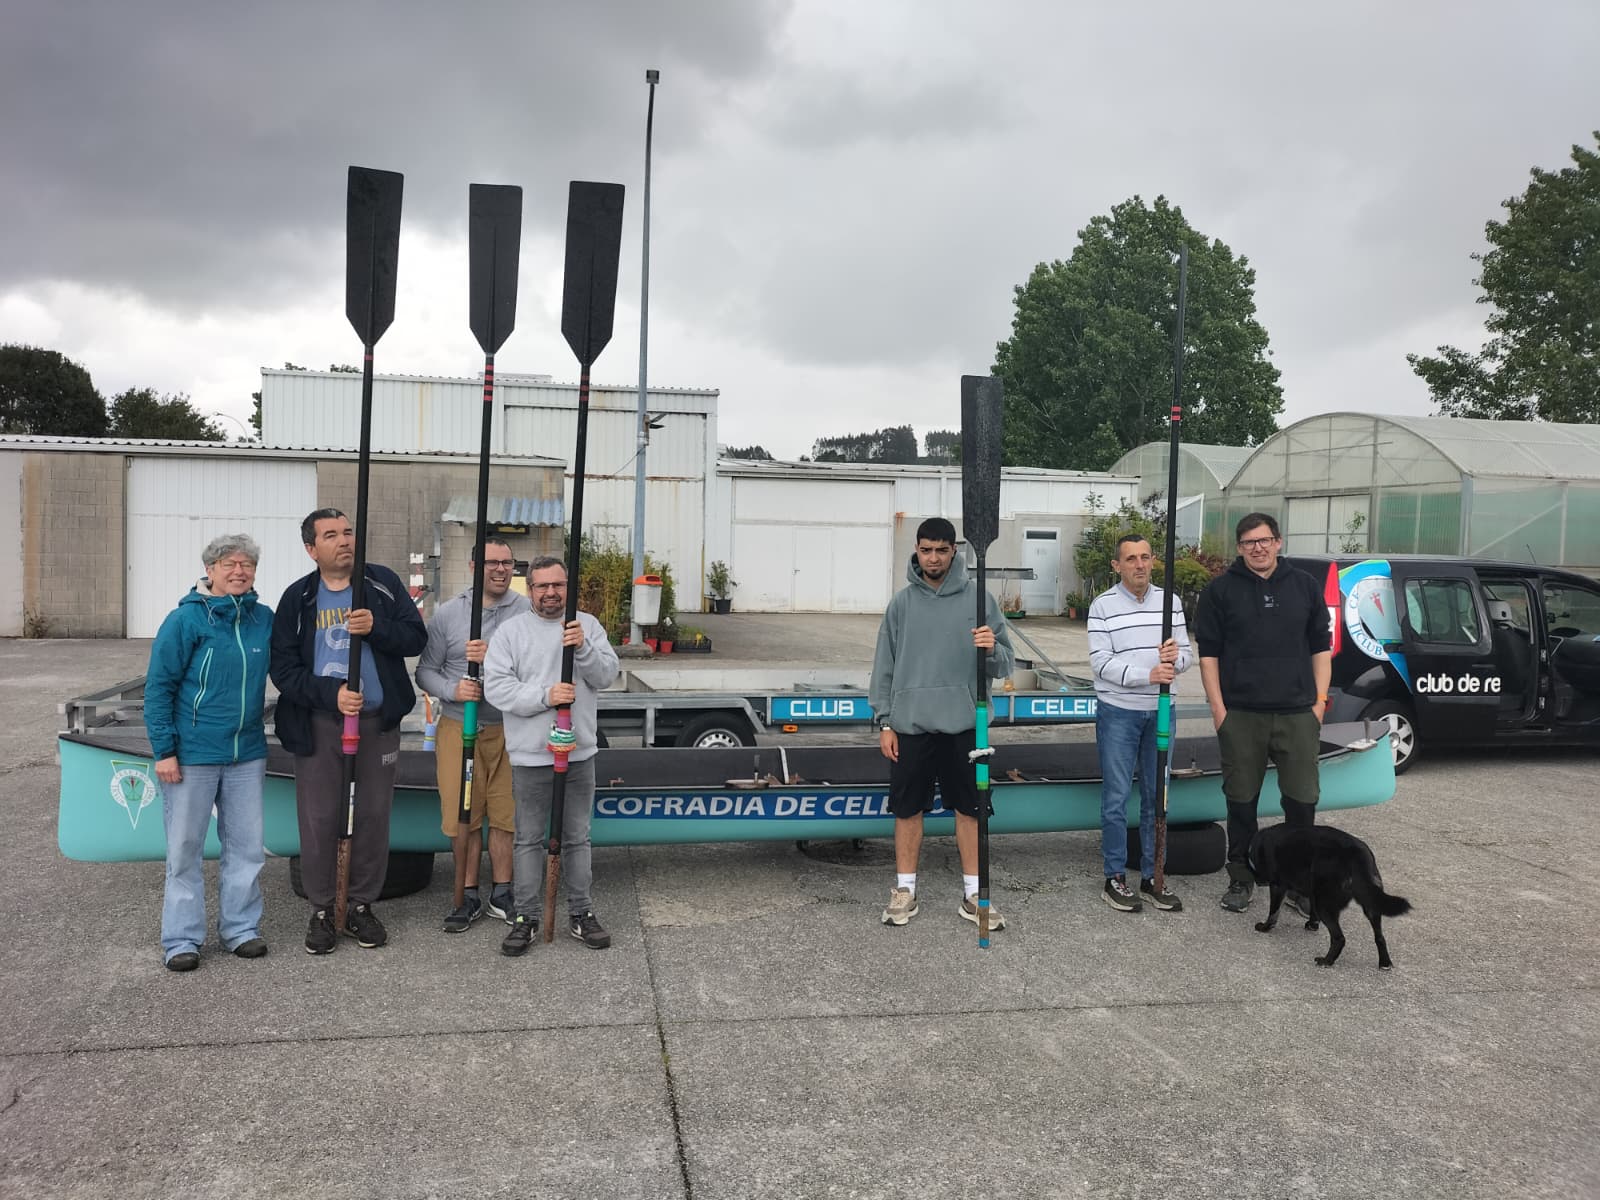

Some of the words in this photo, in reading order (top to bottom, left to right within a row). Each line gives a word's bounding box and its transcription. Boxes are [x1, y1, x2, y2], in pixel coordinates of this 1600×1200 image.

[1416, 673, 1454, 693] club
[1457, 673, 1480, 693] de
[1484, 677, 1501, 693] re
[790, 700, 854, 717] CLUB
[596, 796, 765, 817] COFRADIA
[774, 796, 817, 816] DE
